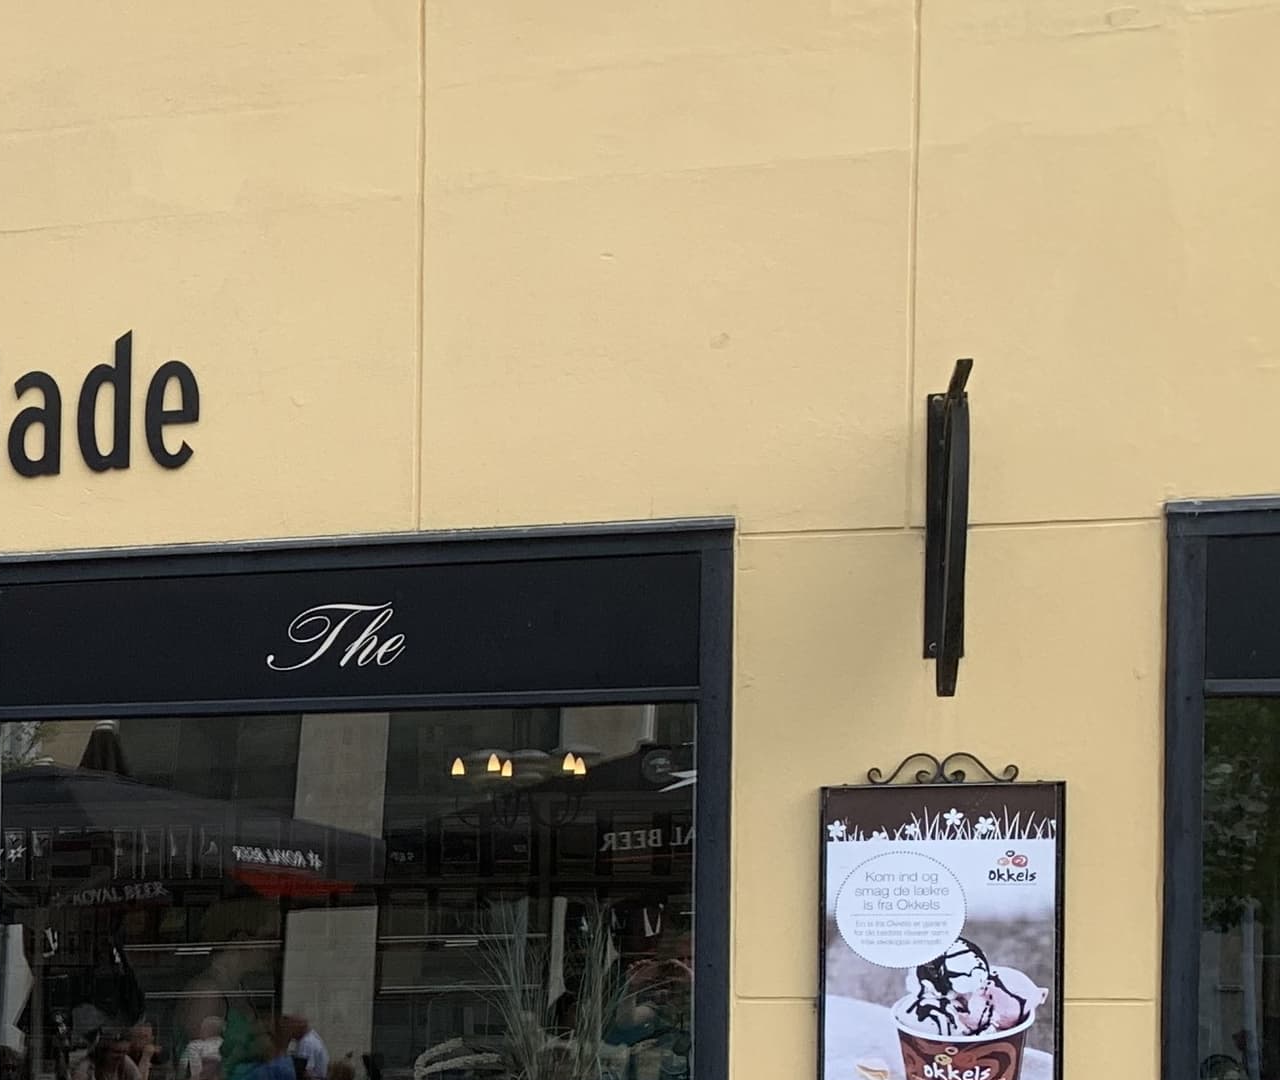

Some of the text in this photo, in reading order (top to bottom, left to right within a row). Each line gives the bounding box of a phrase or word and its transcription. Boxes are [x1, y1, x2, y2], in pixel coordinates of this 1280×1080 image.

[266, 602, 405, 671] The
[865, 871, 938, 885] Kom ind og
[855, 886, 890, 899] smag
[893, 885, 910, 896] de
[877, 899, 893, 910] fra
